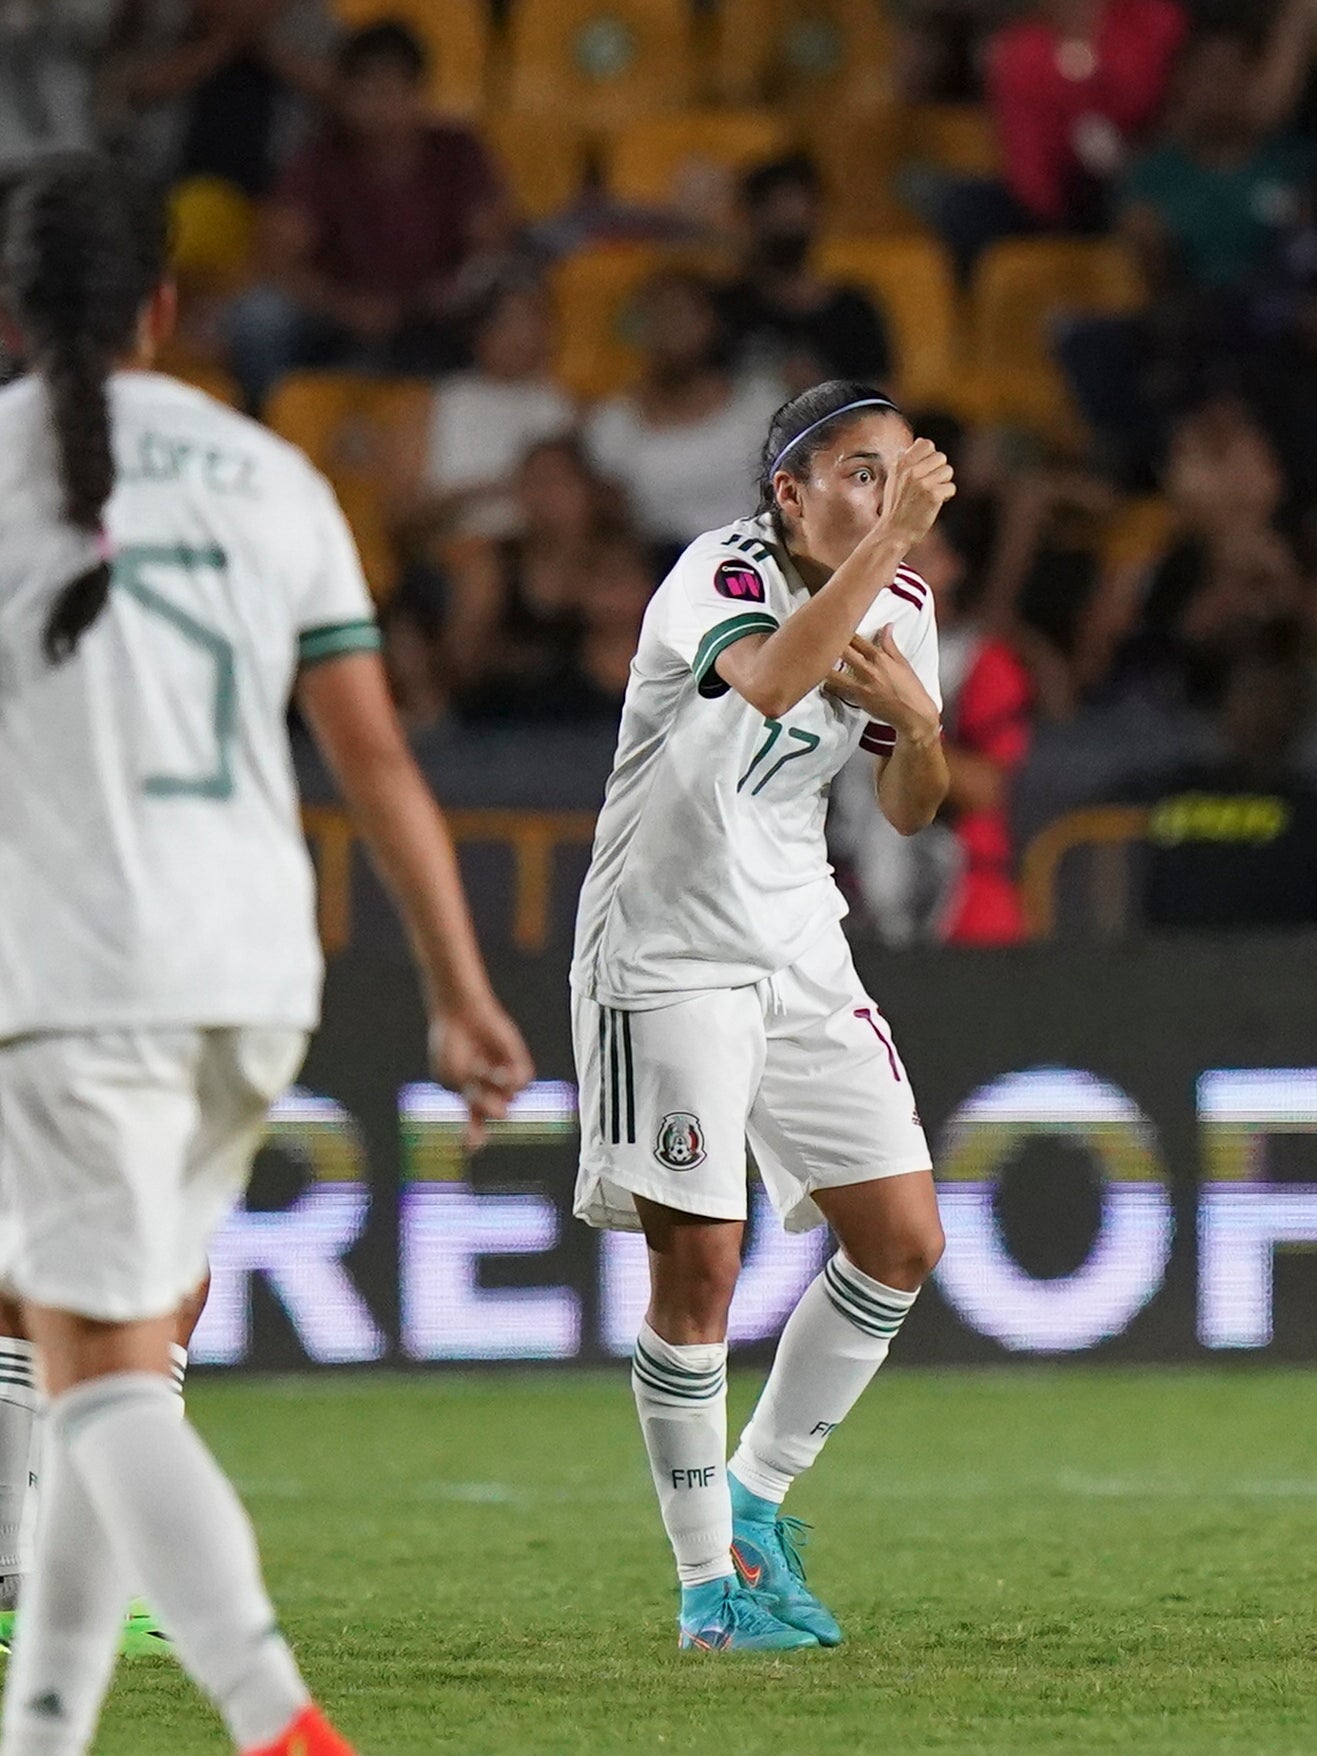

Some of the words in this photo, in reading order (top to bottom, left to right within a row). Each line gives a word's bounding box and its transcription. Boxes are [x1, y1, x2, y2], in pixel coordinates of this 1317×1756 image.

[109, 541, 235, 802] 5
[736, 717, 821, 796] 17
[671, 1465, 716, 1489] FMF
